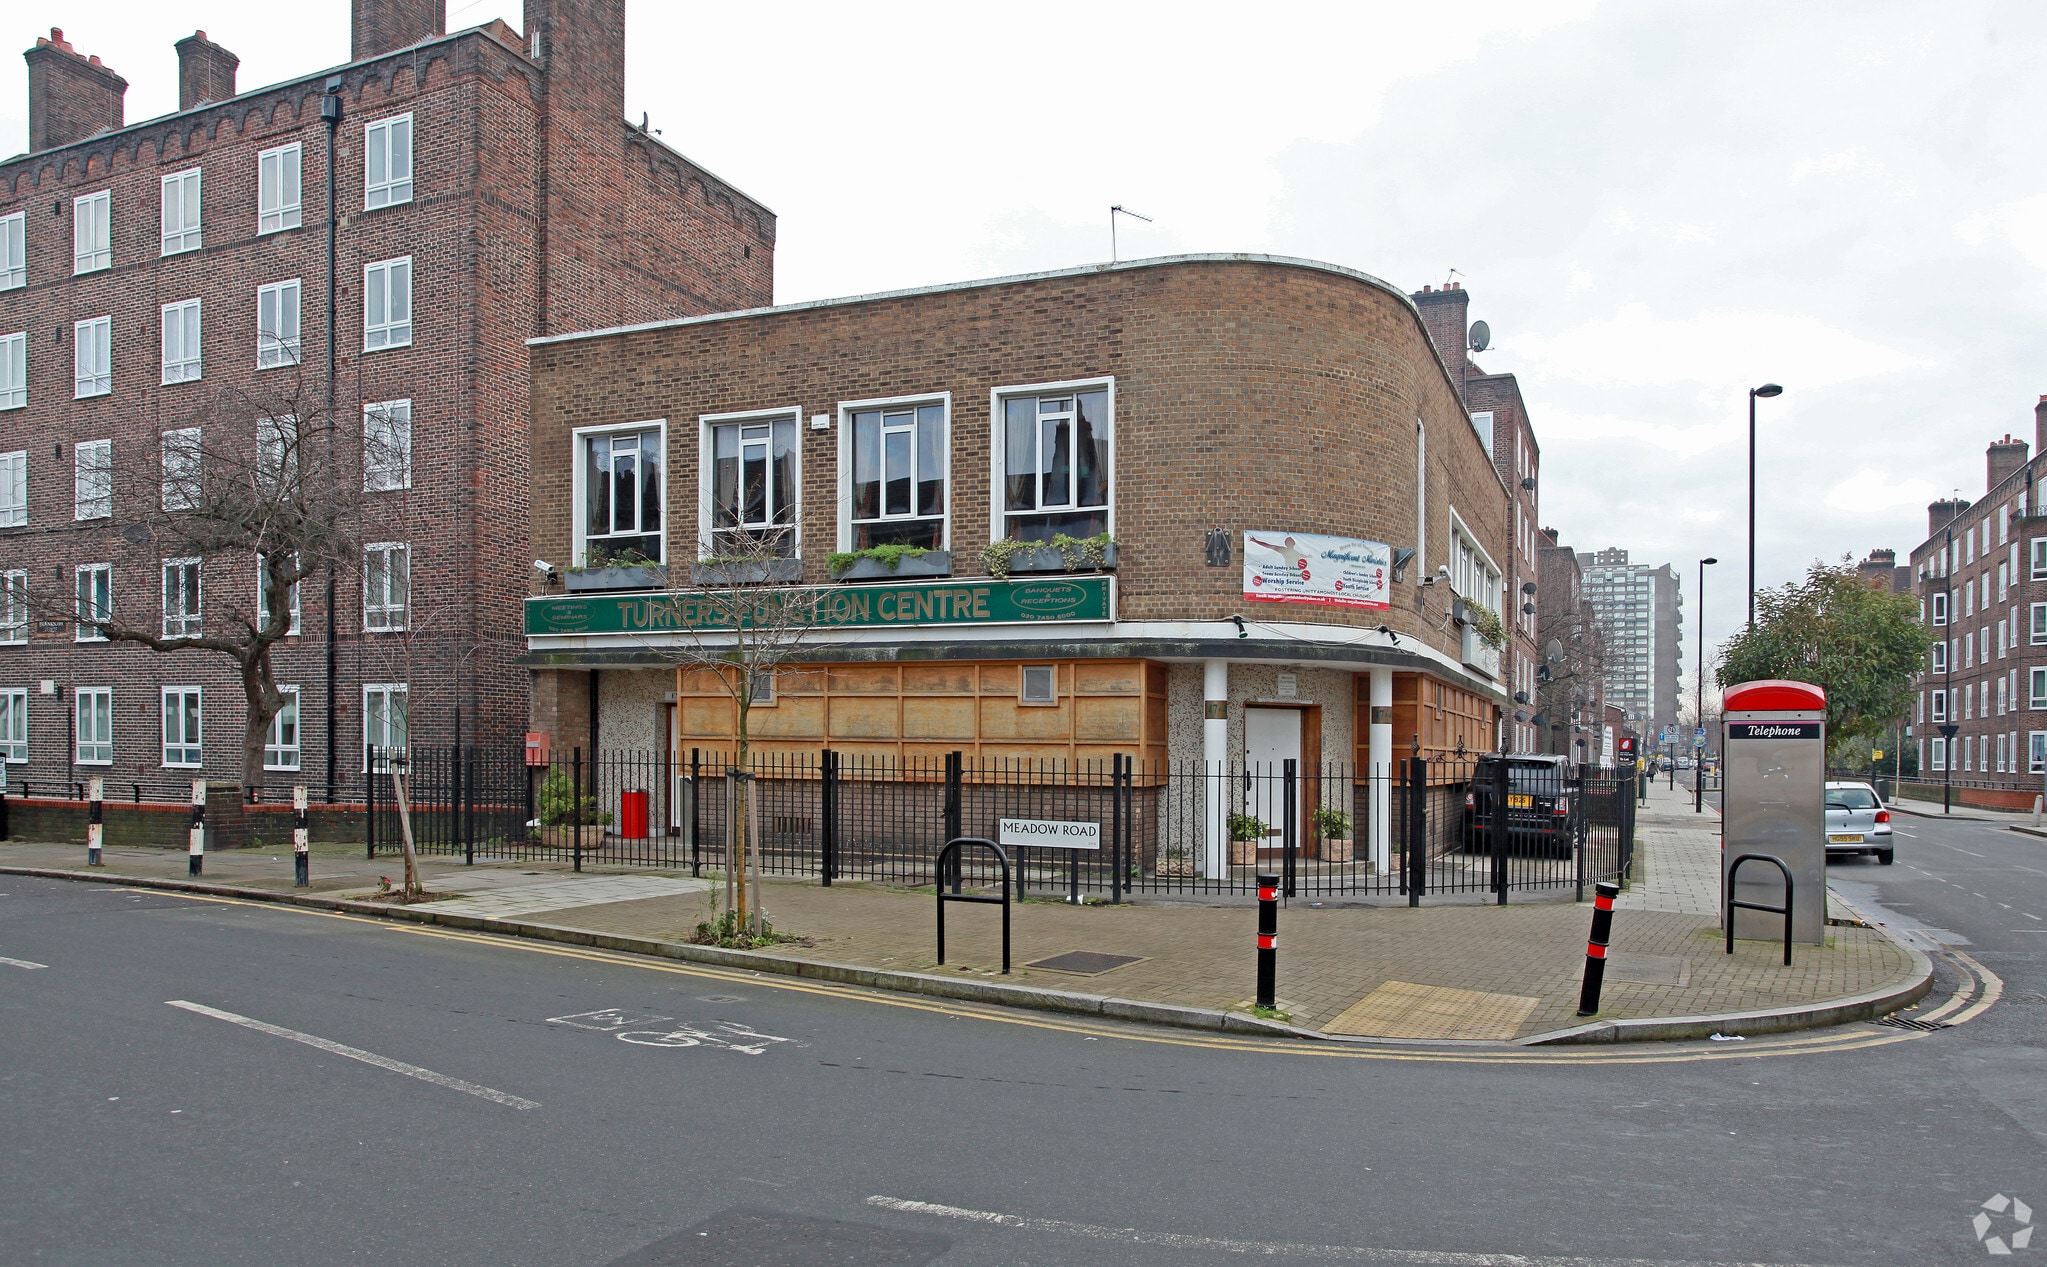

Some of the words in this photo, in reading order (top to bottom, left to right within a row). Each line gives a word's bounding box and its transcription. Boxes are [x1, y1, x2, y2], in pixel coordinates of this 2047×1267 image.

[1262, 578, 1284, 586] Worship
[1286, 578, 1305, 586] Service
[1025, 586, 1073, 594] BANQUETS
[1020, 597, 1077, 605] RECEPTIONS
[617, 600, 730, 629] TURNERS
[877, 588, 991, 621] CENTRE
[1747, 725, 1801, 738] Telephone
[1003, 822, 1059, 835] MEADOW
[1062, 825, 1097, 837] ROAD
